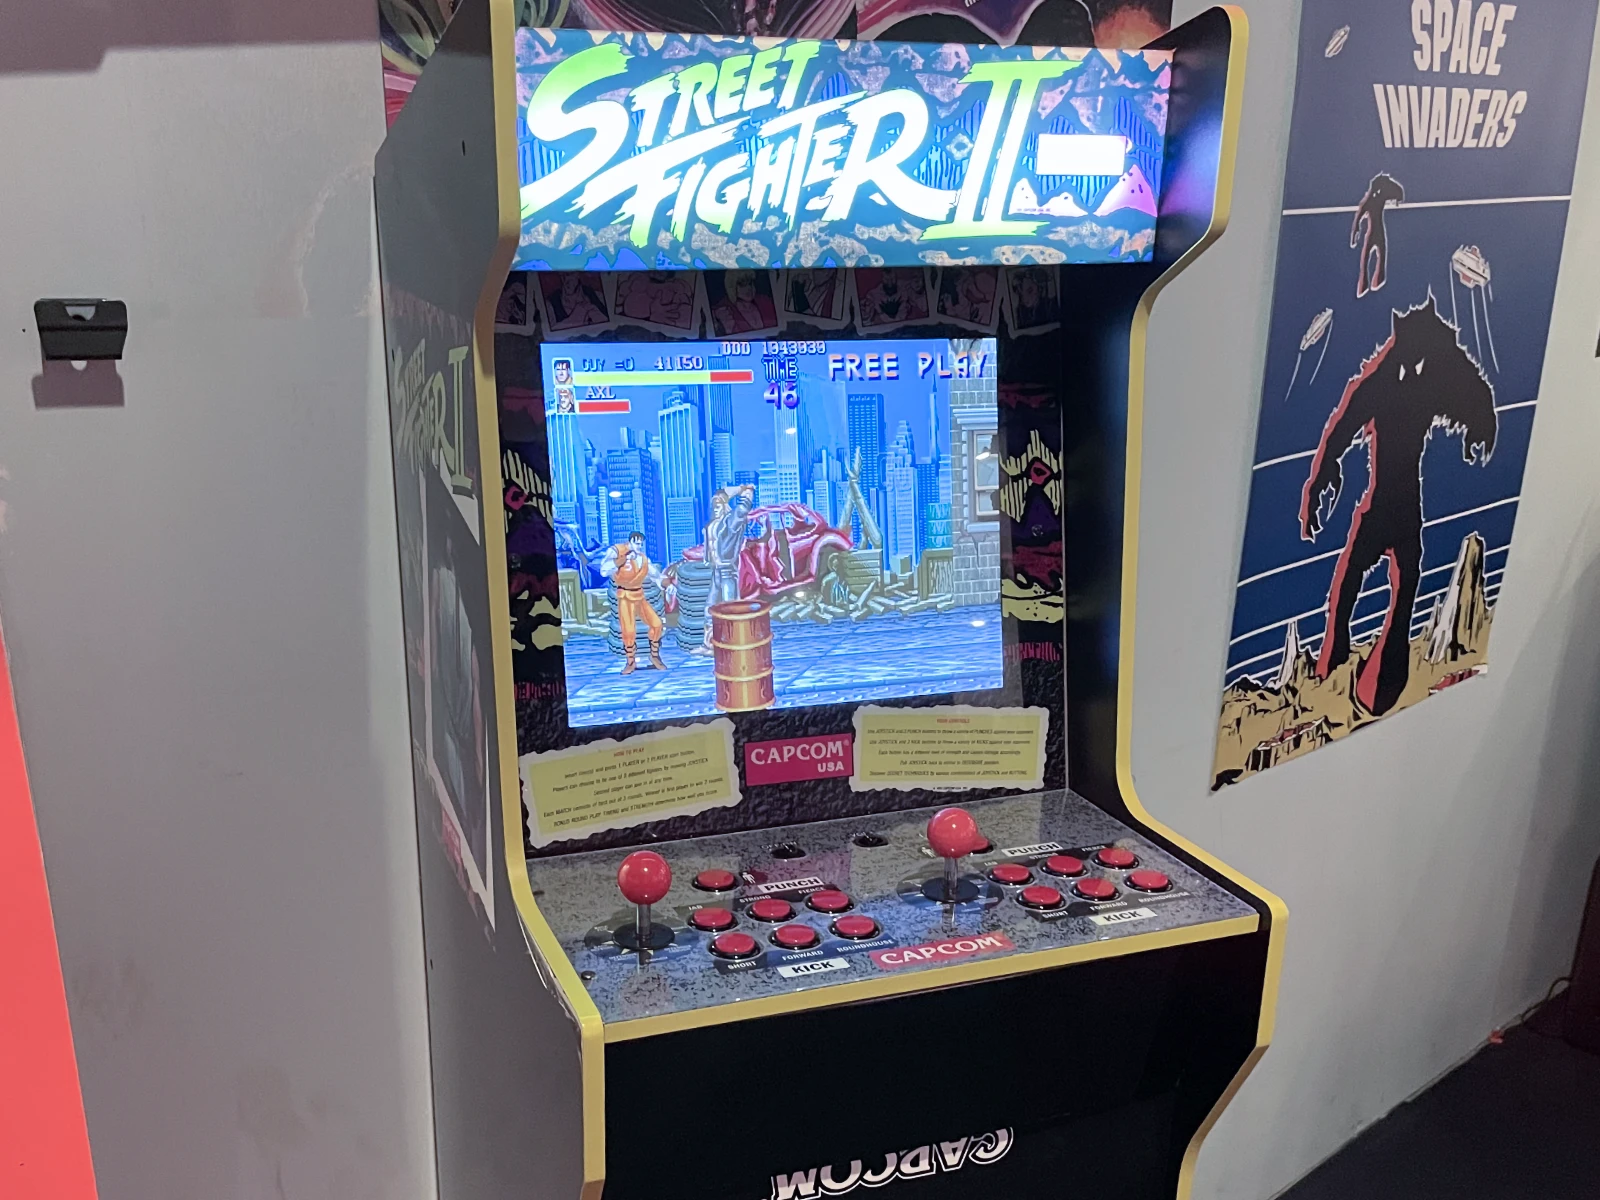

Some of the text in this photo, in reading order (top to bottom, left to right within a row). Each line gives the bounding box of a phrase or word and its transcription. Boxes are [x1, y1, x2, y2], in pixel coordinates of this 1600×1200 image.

[1411, 0, 1517, 75] SPACE
[1373, 84, 1527, 148] INVADERS
[521, 41, 820, 219] STREET
[571, 60, 1083, 247] FIGHTER II
[654, 355, 704, 371] 41150
[761, 354, 799, 382] TIME
[828, 351, 988, 381] FREE PLAY
[586, 386, 616, 400] AXL
[764, 381, 800, 409] 46
[750, 740, 844, 765] CAPCOM
[817, 763, 844, 773] USA
[1008, 843, 1059, 855] PUNCH
[764, 878, 821, 891] PUNCH
[739, 894, 771, 903] STRONG
[1042, 911, 1069, 919] SHORT
[1103, 910, 1143, 922] KICK
[837, 939, 894, 952] ROUNDHOUSE
[880, 936, 1003, 965] CAPCOM
[781, 950, 824, 961] FORWARD
[727, 960, 757, 970] SHORT
[791, 960, 834, 974] KICK
